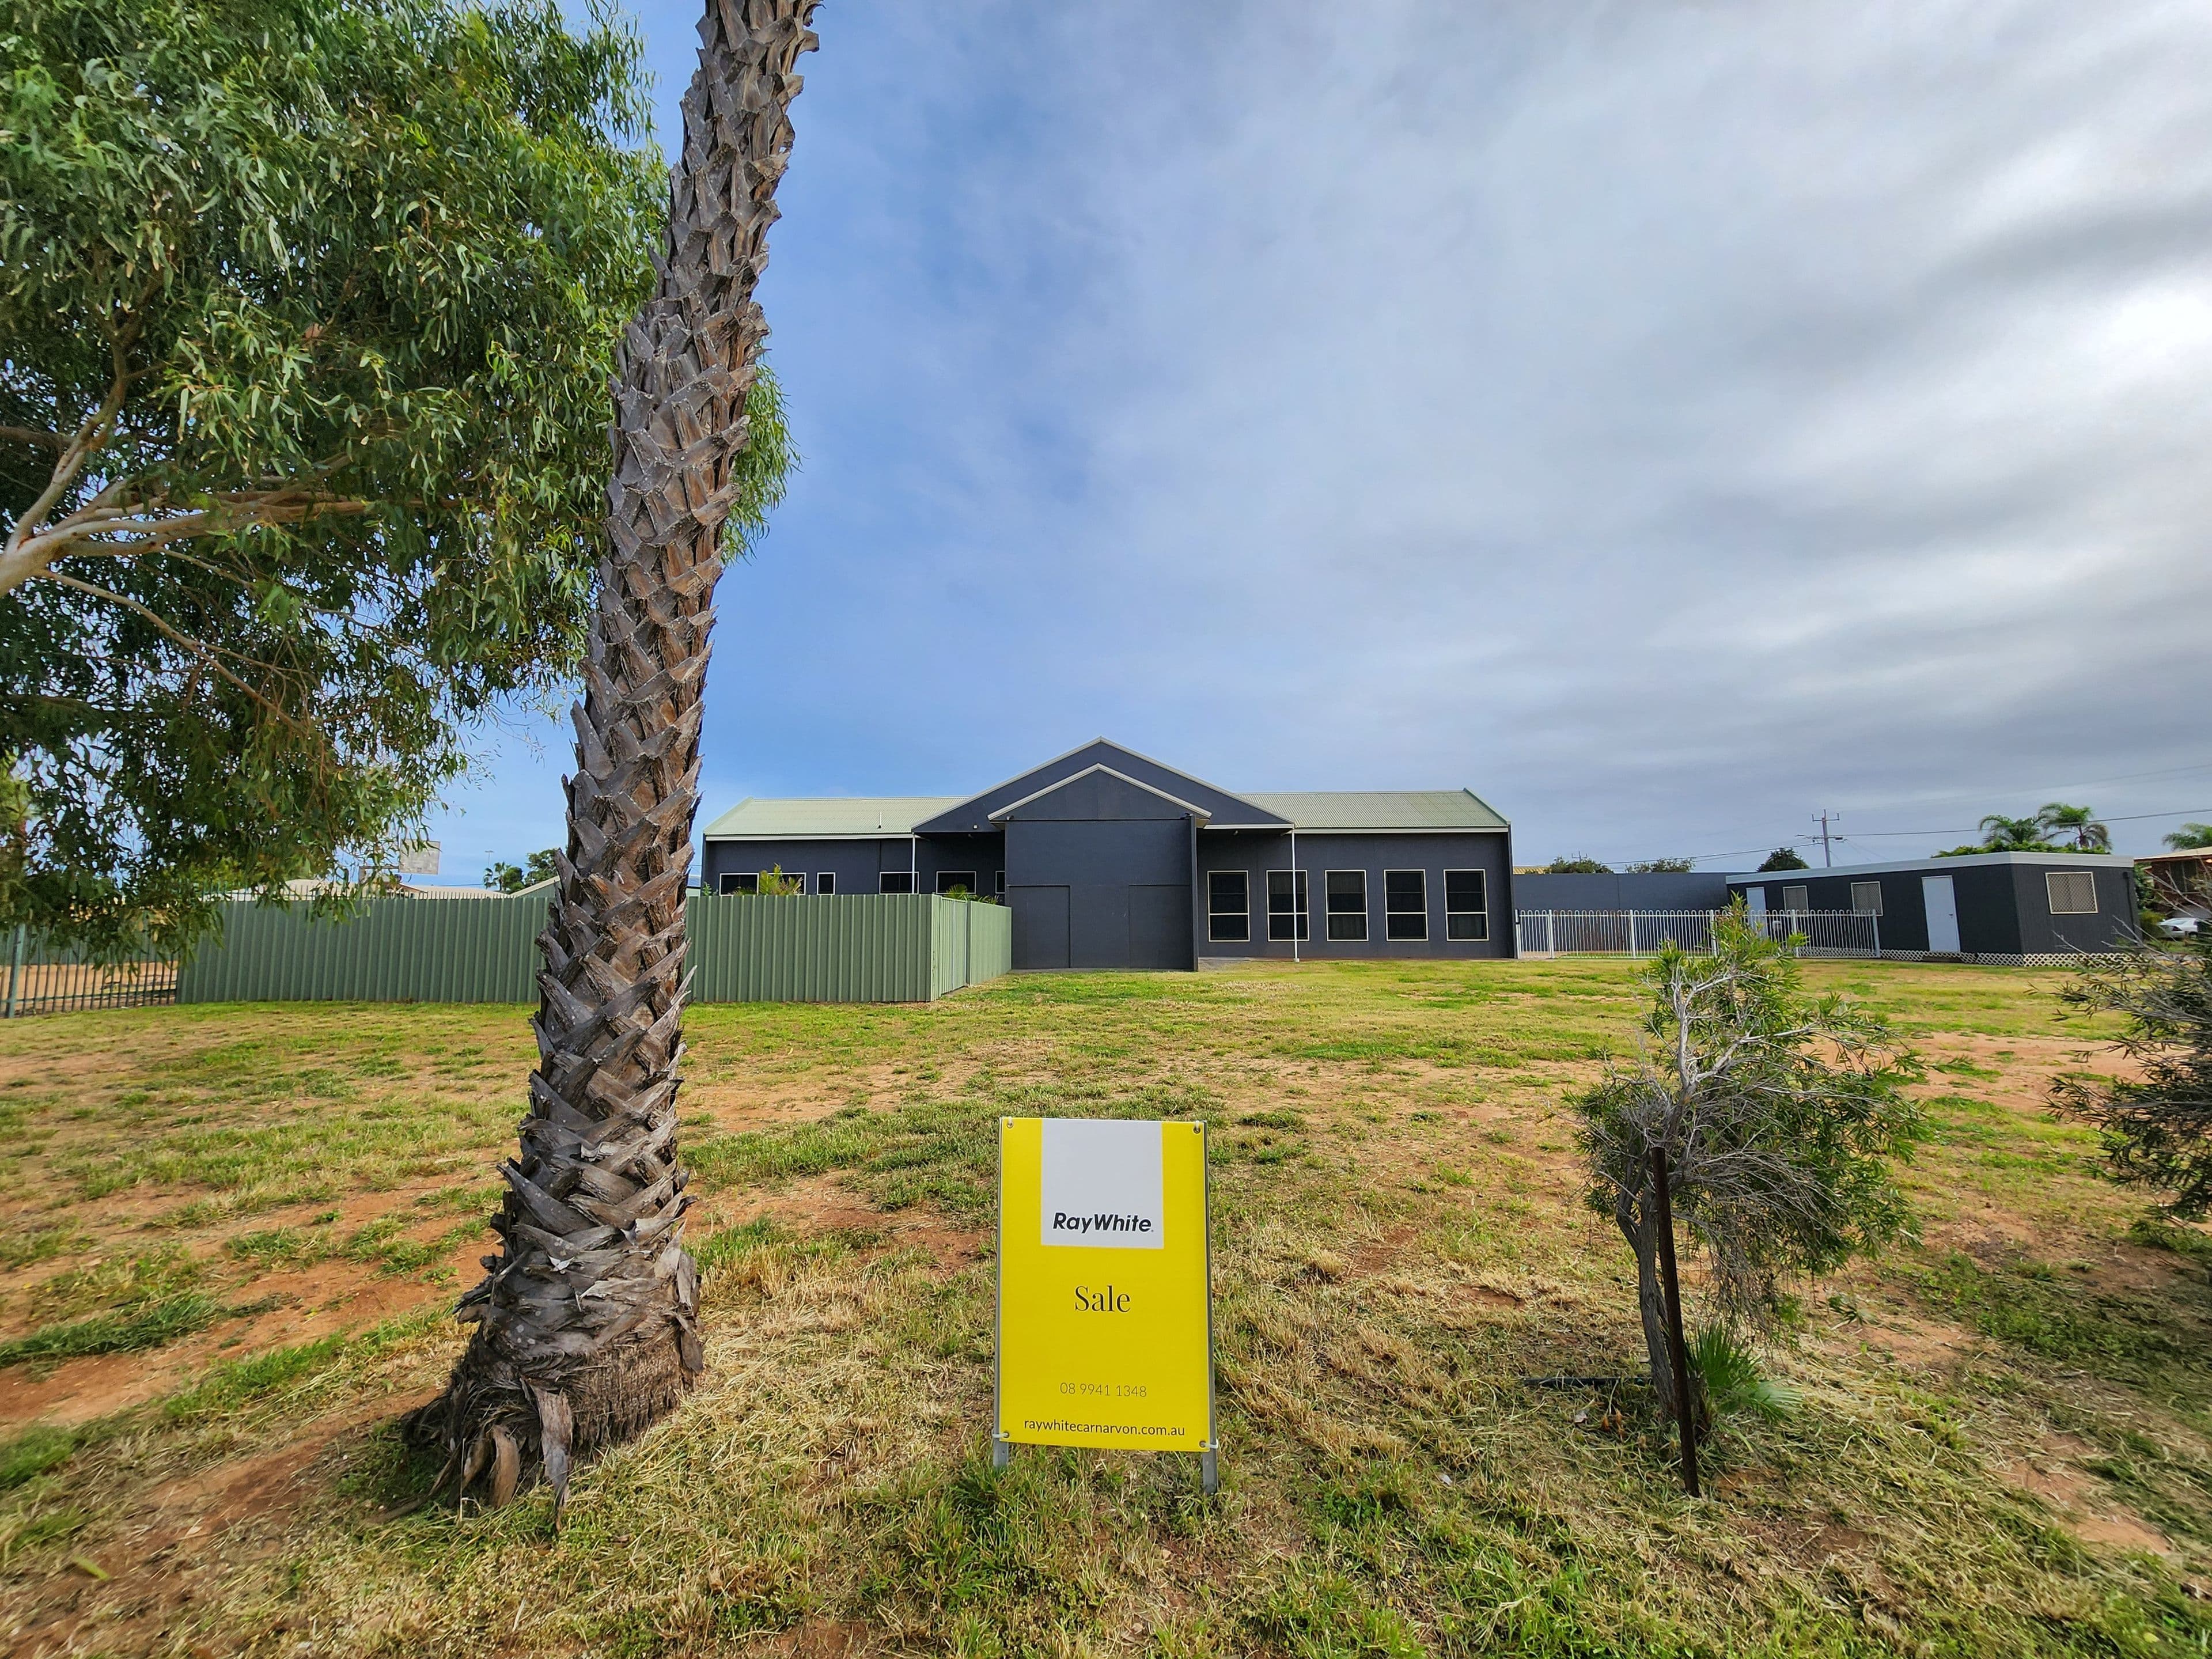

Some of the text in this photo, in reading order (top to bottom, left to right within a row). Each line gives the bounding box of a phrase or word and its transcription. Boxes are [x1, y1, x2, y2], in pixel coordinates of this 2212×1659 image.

[1075, 1285, 1131, 1313] Sale
[1060, 1382, 1147, 1397] 08 9941 1348
[1024, 1419, 1185, 1436] raywhitecarnarvon.com.au
